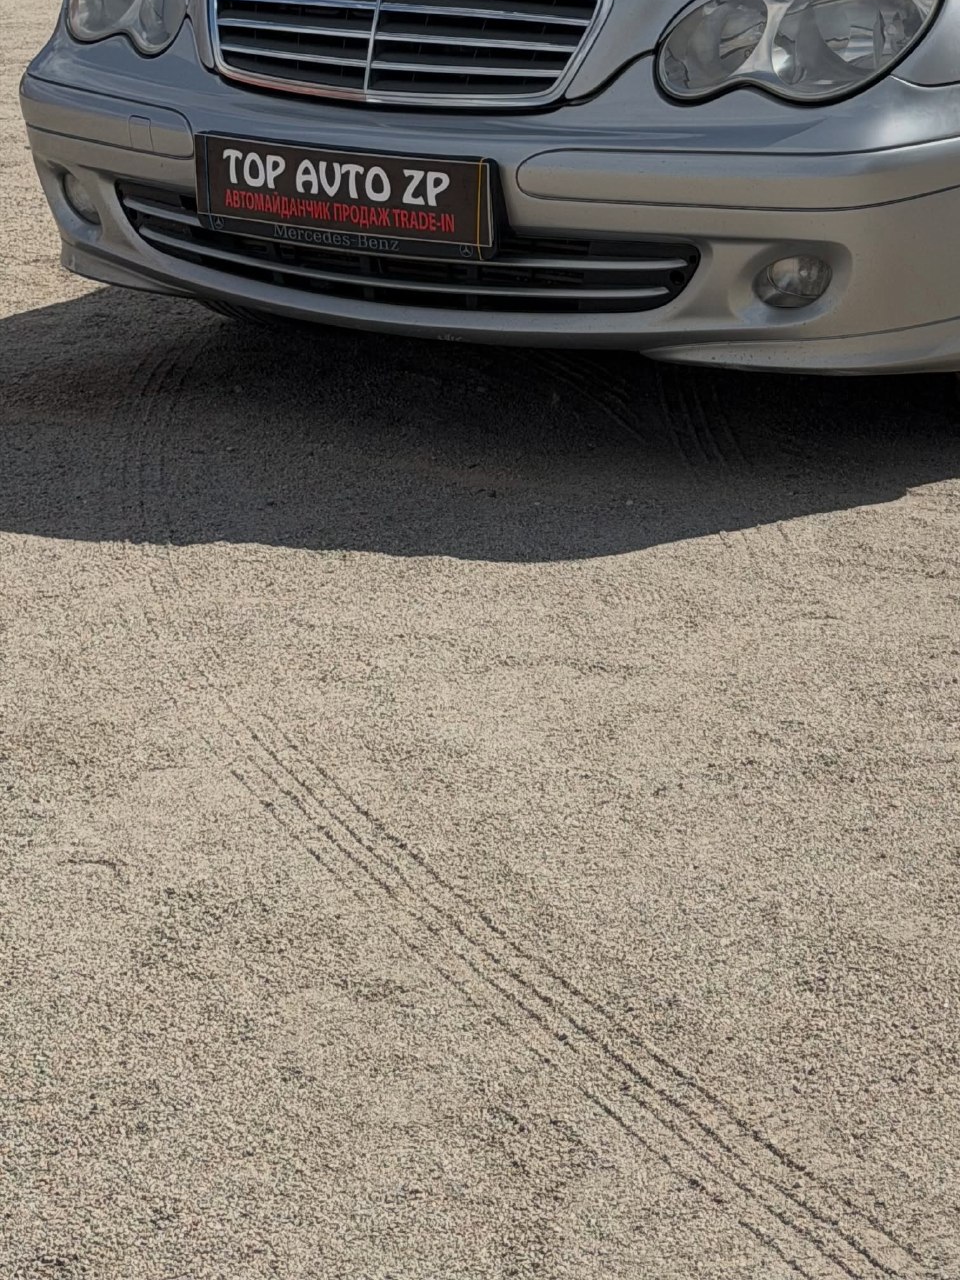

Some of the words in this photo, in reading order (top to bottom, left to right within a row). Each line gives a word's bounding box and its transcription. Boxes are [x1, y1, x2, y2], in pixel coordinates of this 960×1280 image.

[223, 149, 286, 189] TOP
[402, 169, 450, 207] ZP
[225, 188, 330, 220] АВТОМАЙДАНЧИК
[333, 204, 390, 228] ПРОДАЖ
[392, 209, 455, 233] TRADE-IN
[273, 224, 400, 252] Mercedes-Benz
